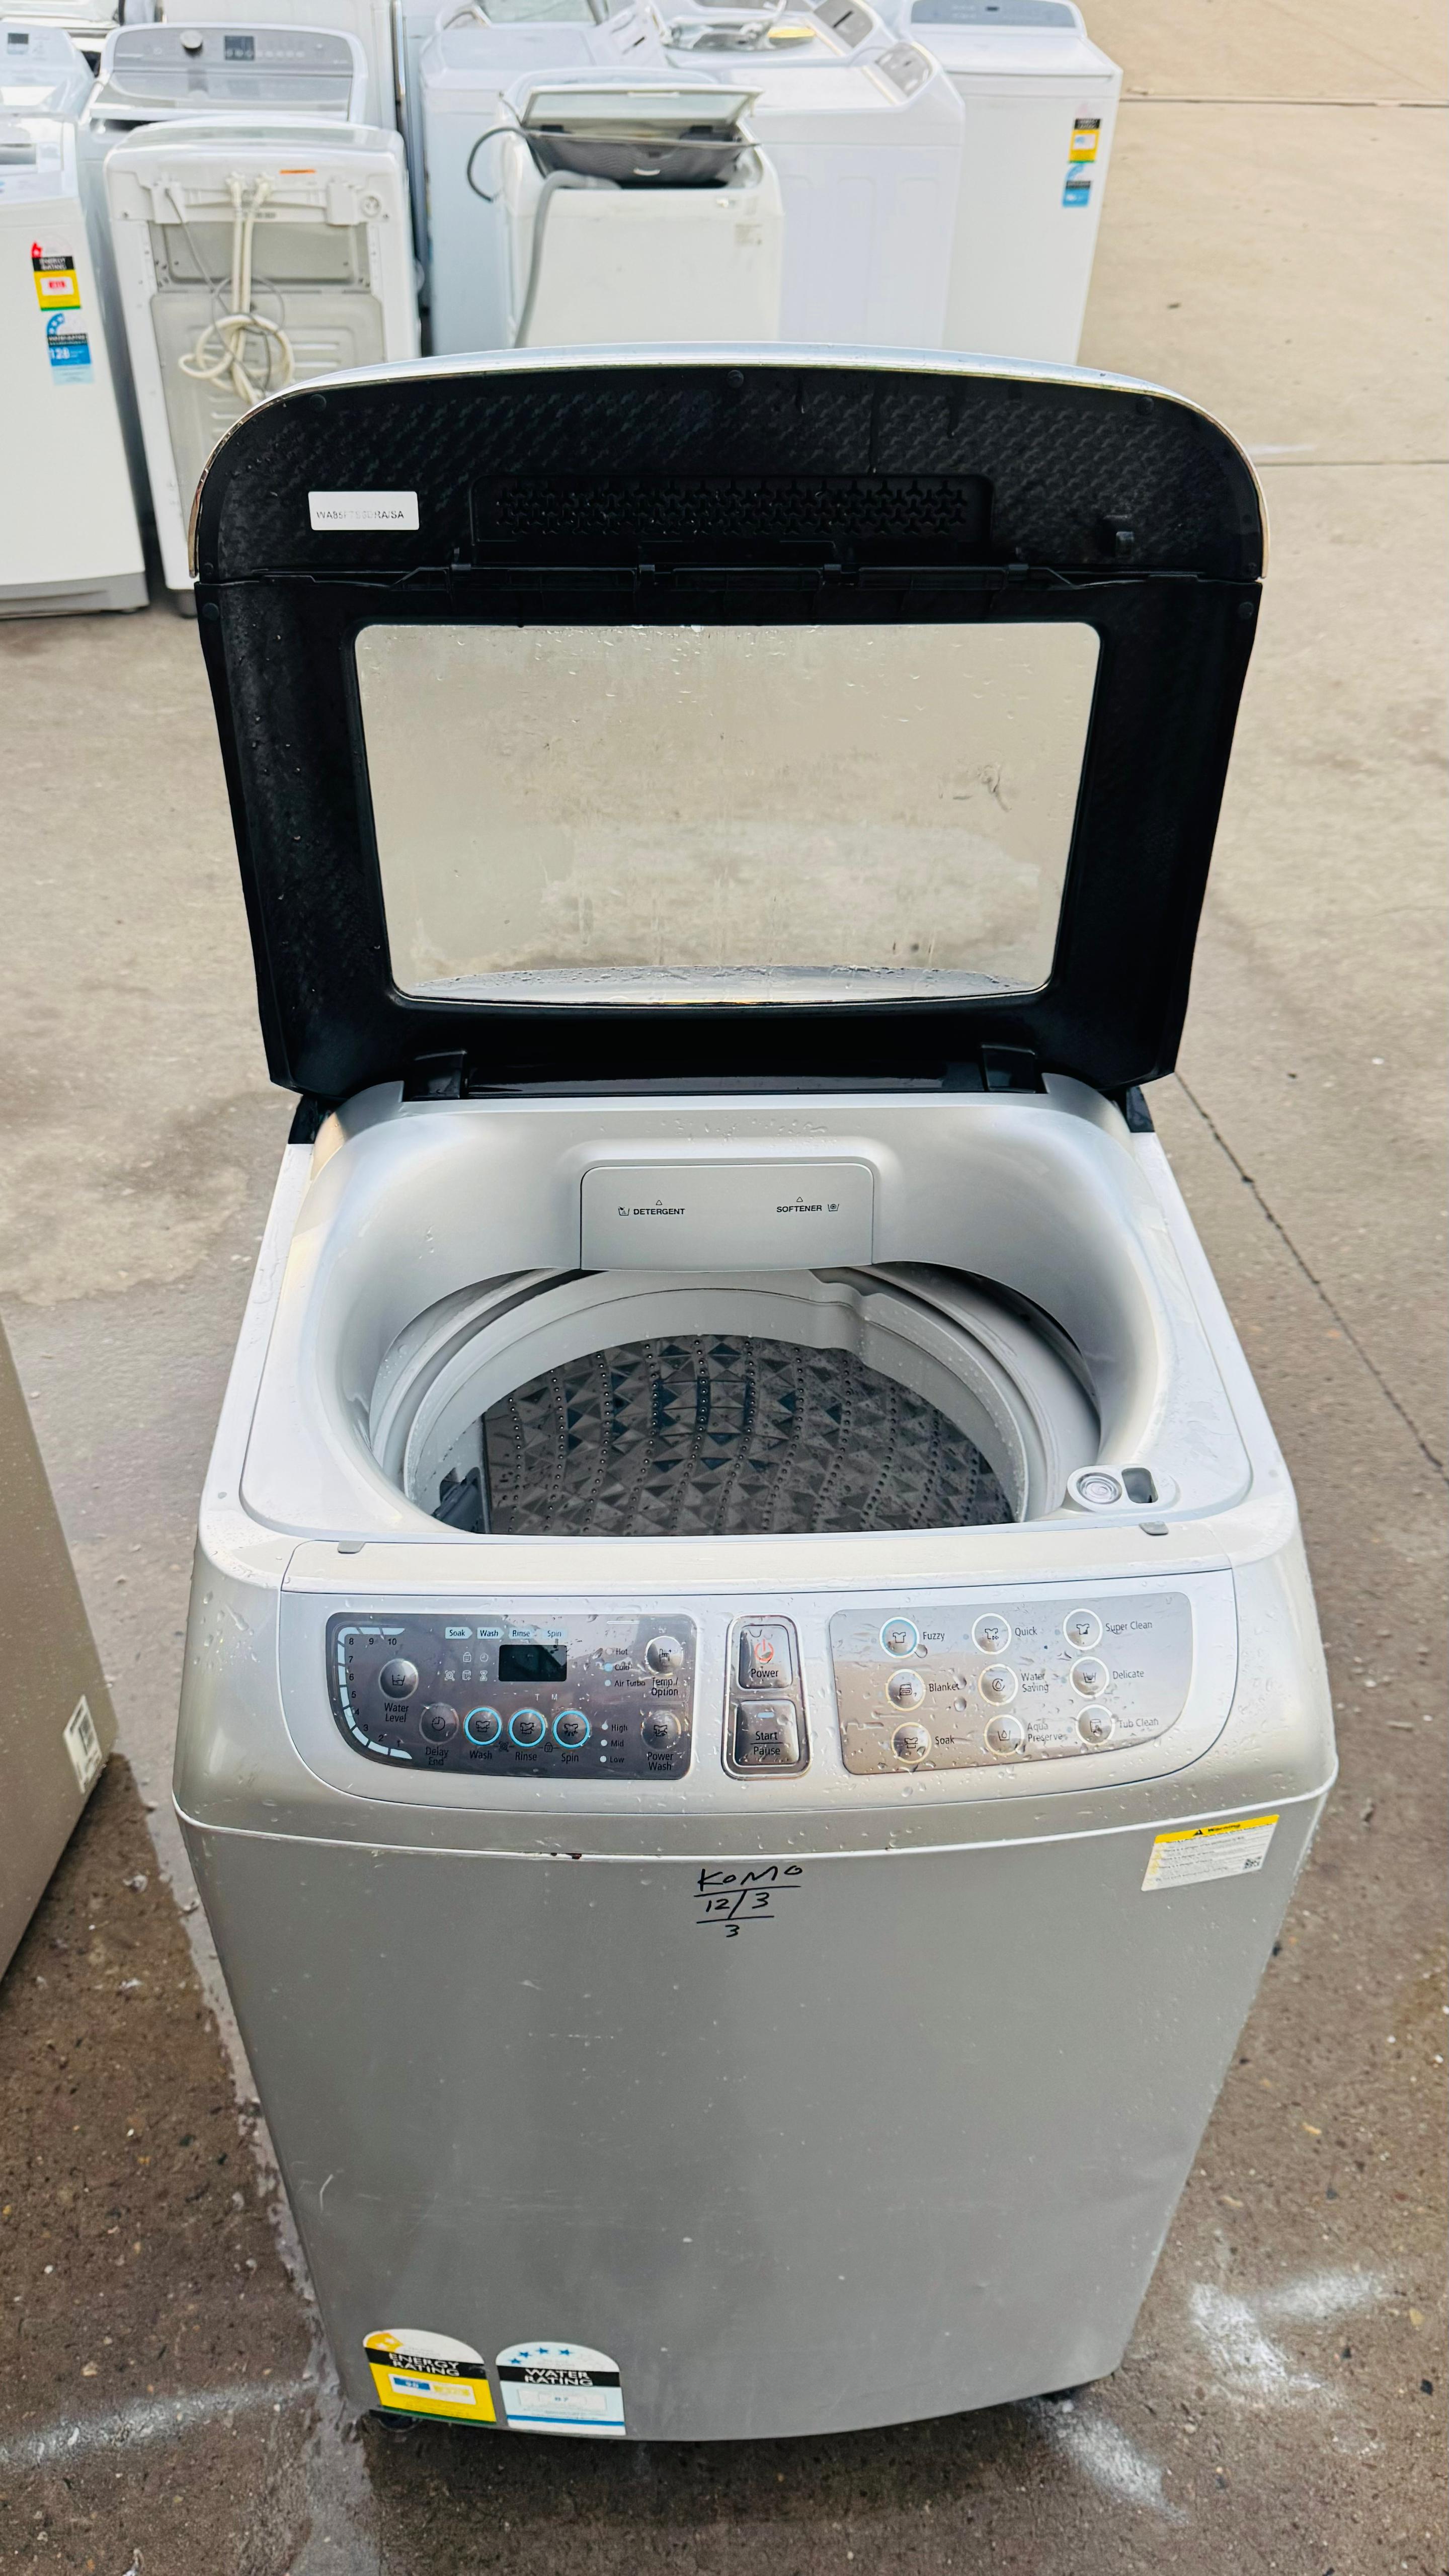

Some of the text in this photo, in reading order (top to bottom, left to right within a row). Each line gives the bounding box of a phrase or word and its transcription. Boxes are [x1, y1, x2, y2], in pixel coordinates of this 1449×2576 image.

[776, 1204, 823, 1213] SOFTENER
[1015, 1626, 1038, 1637] Quick
[1105, 1620, 1153, 1634] Super Clean
[449, 1629, 465, 1637] Soak
[480, 1629, 499, 1637] Wash
[547, 1629, 562, 1639] Spin
[923, 1631, 945, 1642] Fuzzy
[751, 1668, 779, 1678] Power
[1020, 1672, 1045, 1681] Water
[1112, 1670, 1145, 1680] Delicate
[929, 1681, 960, 1693] Blanket
[1022, 1683, 1049, 1693] Saving
[351, 1691, 357, 1699] 5
[651, 1687, 679, 1698] Option
[384, 1702, 409, 1713] Water
[385, 1713, 407, 1723] Level
[1117, 1718, 1159, 1728] Tub Clean
[363, 1724, 369, 1732] 3
[611, 1724, 628, 1733] High
[1027, 1721, 1049, 1731] Aqua
[755, 1731, 778, 1741] Start
[935, 1735, 955, 1745] Soak
[1027, 1733, 1063, 1743] Preserve
[611, 1739, 624, 1747] Mid
[426, 1746, 449, 1758] Delay
[469, 1750, 493, 1760] Wash
[753, 1745, 781, 1755] Pause
[515, 1751, 537, 1761] Rinse
[561, 1753, 579, 1764] Spin
[647, 1751, 674, 1761] Power
[428, 1757, 444, 1766] End
[648, 1761, 672, 1771] Wash
[725, 1924, 740, 1938] 3
[389, 2353, 460, 2370] ENERGY
[392, 2360, 460, 2377] RATING
[525, 2368, 589, 2380] WATER
[524, 2374, 594, 2387] RATING
